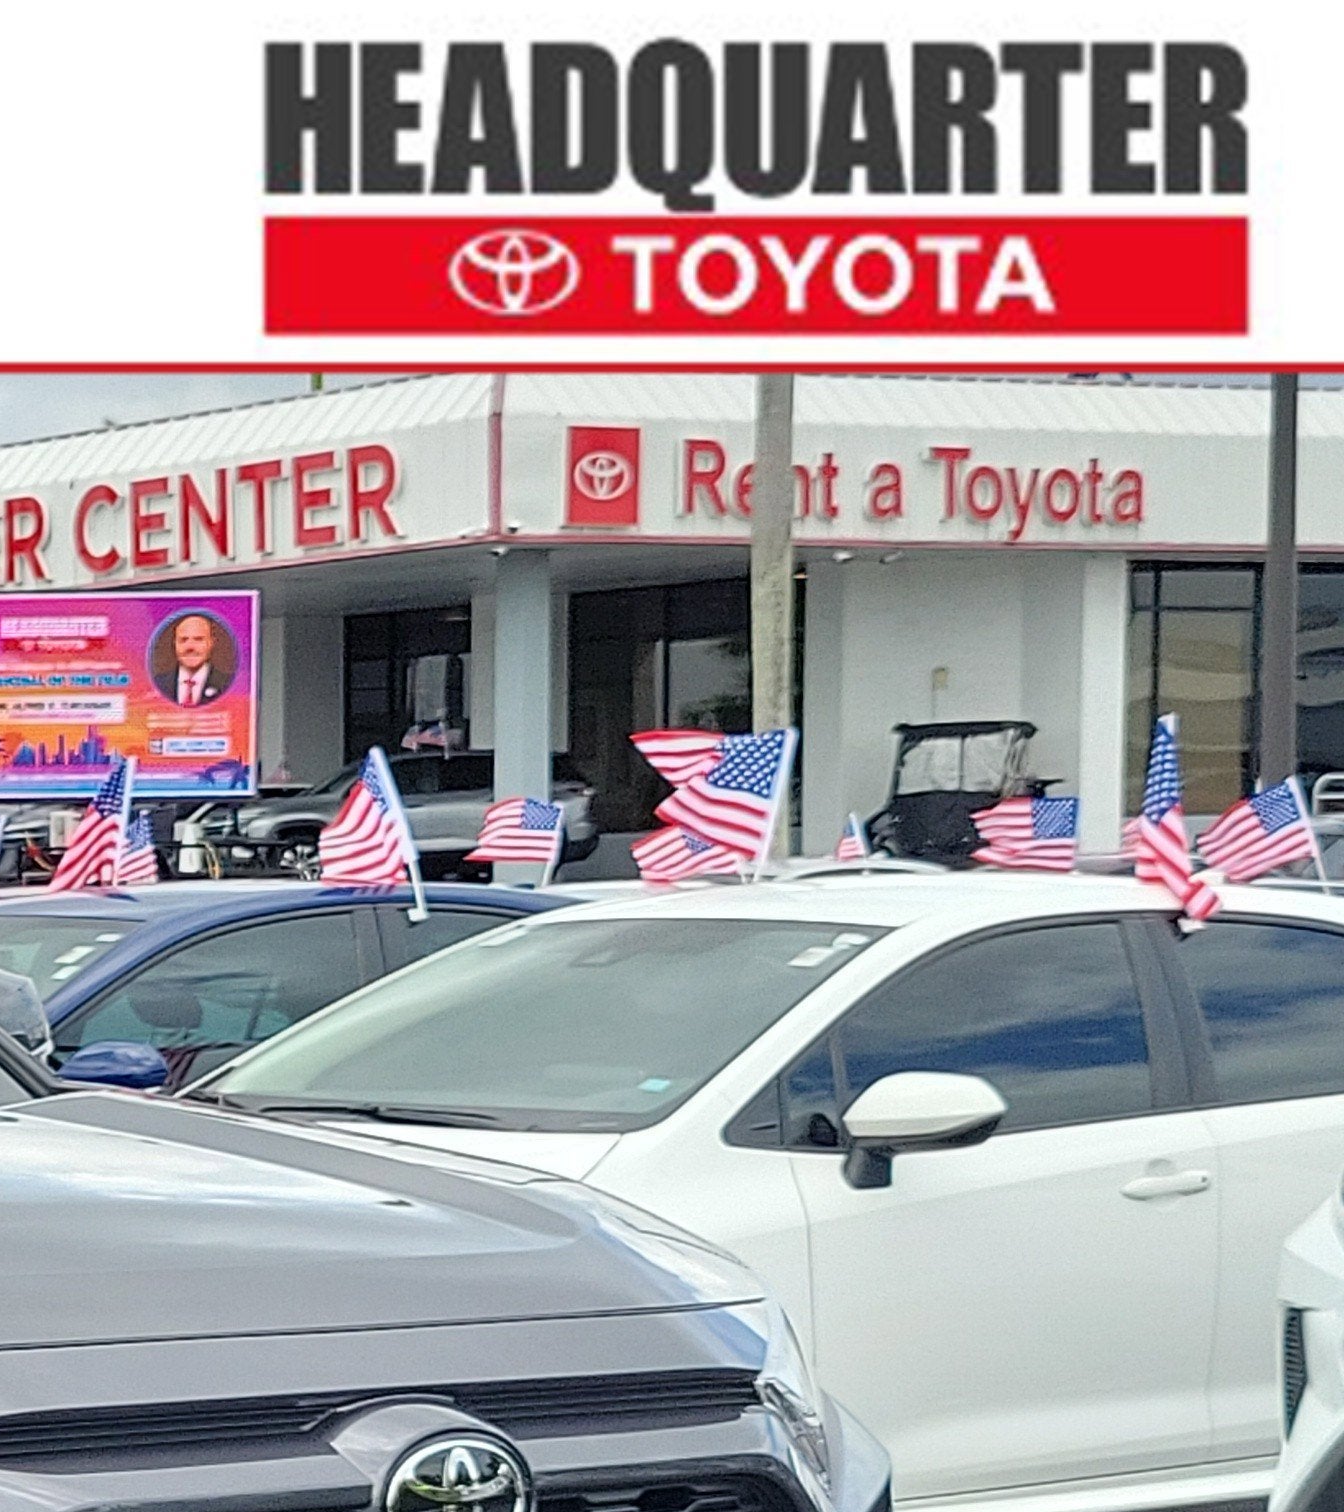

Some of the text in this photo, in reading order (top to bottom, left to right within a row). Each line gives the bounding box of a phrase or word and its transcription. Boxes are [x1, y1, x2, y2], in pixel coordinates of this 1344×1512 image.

[74, 444, 401, 574] CENTER
[867, 463, 904, 519] a
[929, 446, 1145, 541] Toyota
